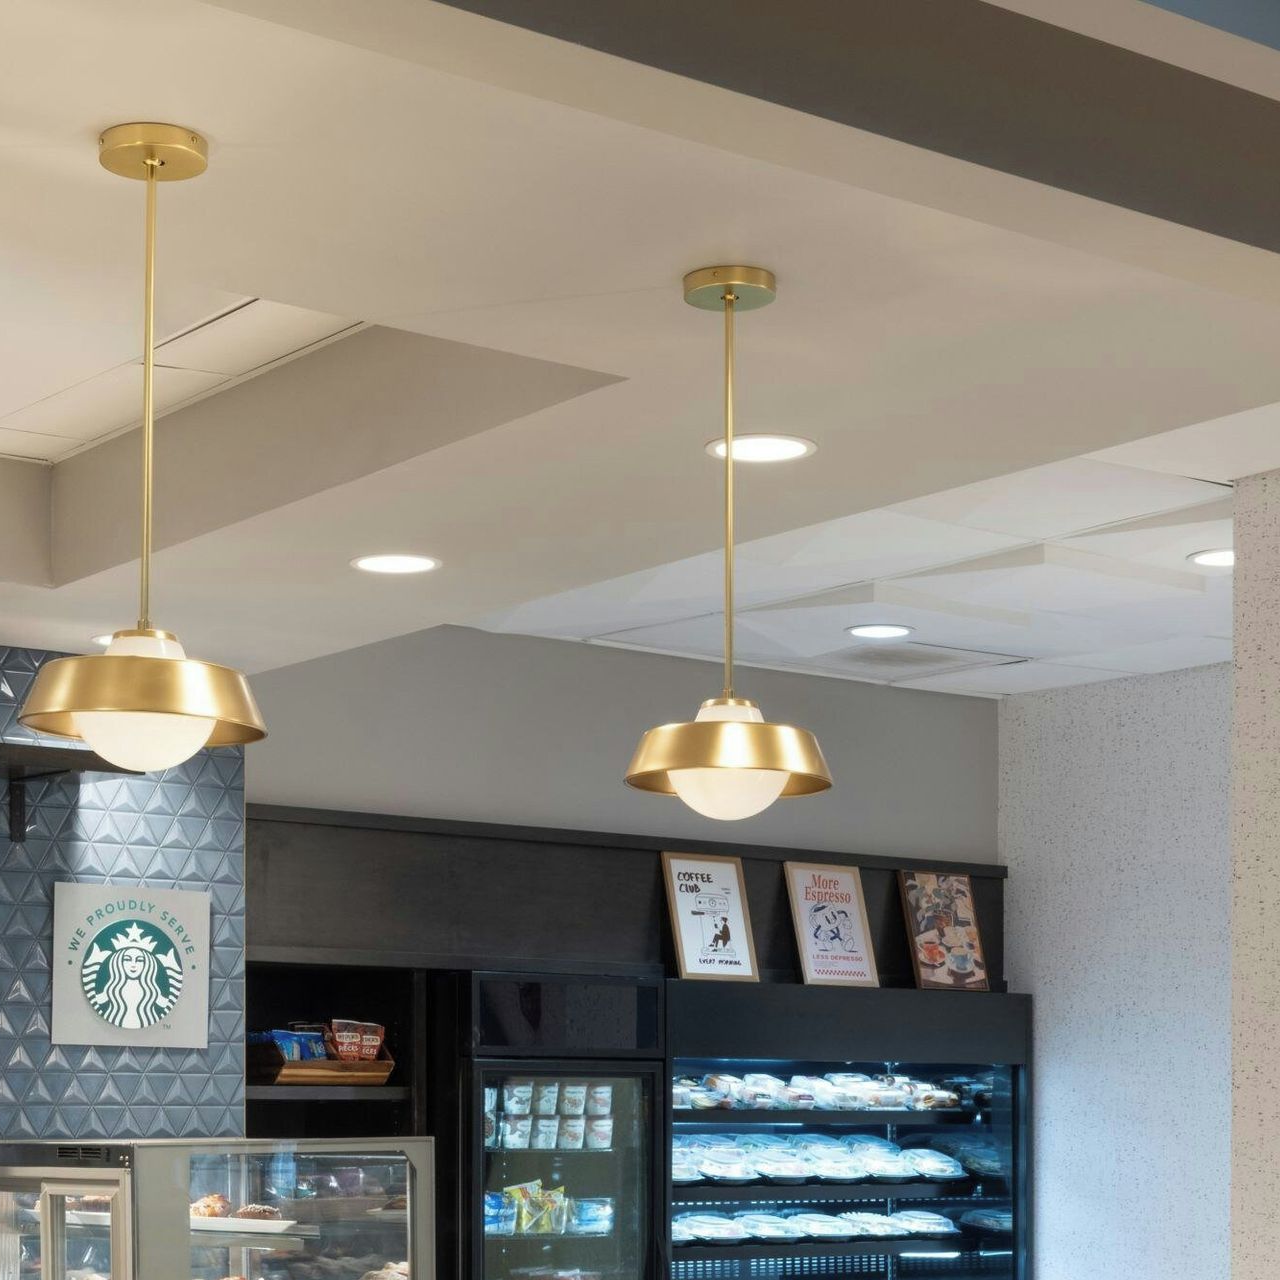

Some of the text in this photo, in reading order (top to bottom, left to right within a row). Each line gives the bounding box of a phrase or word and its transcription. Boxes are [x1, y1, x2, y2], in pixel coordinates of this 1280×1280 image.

[677, 871, 713, 883] COFFEE
[811, 873, 839, 890] More
[679, 883, 701, 893] CLUB
[804, 886, 851, 904] Espresso
[68, 900, 195, 955] WE PROUDLY SERVE
